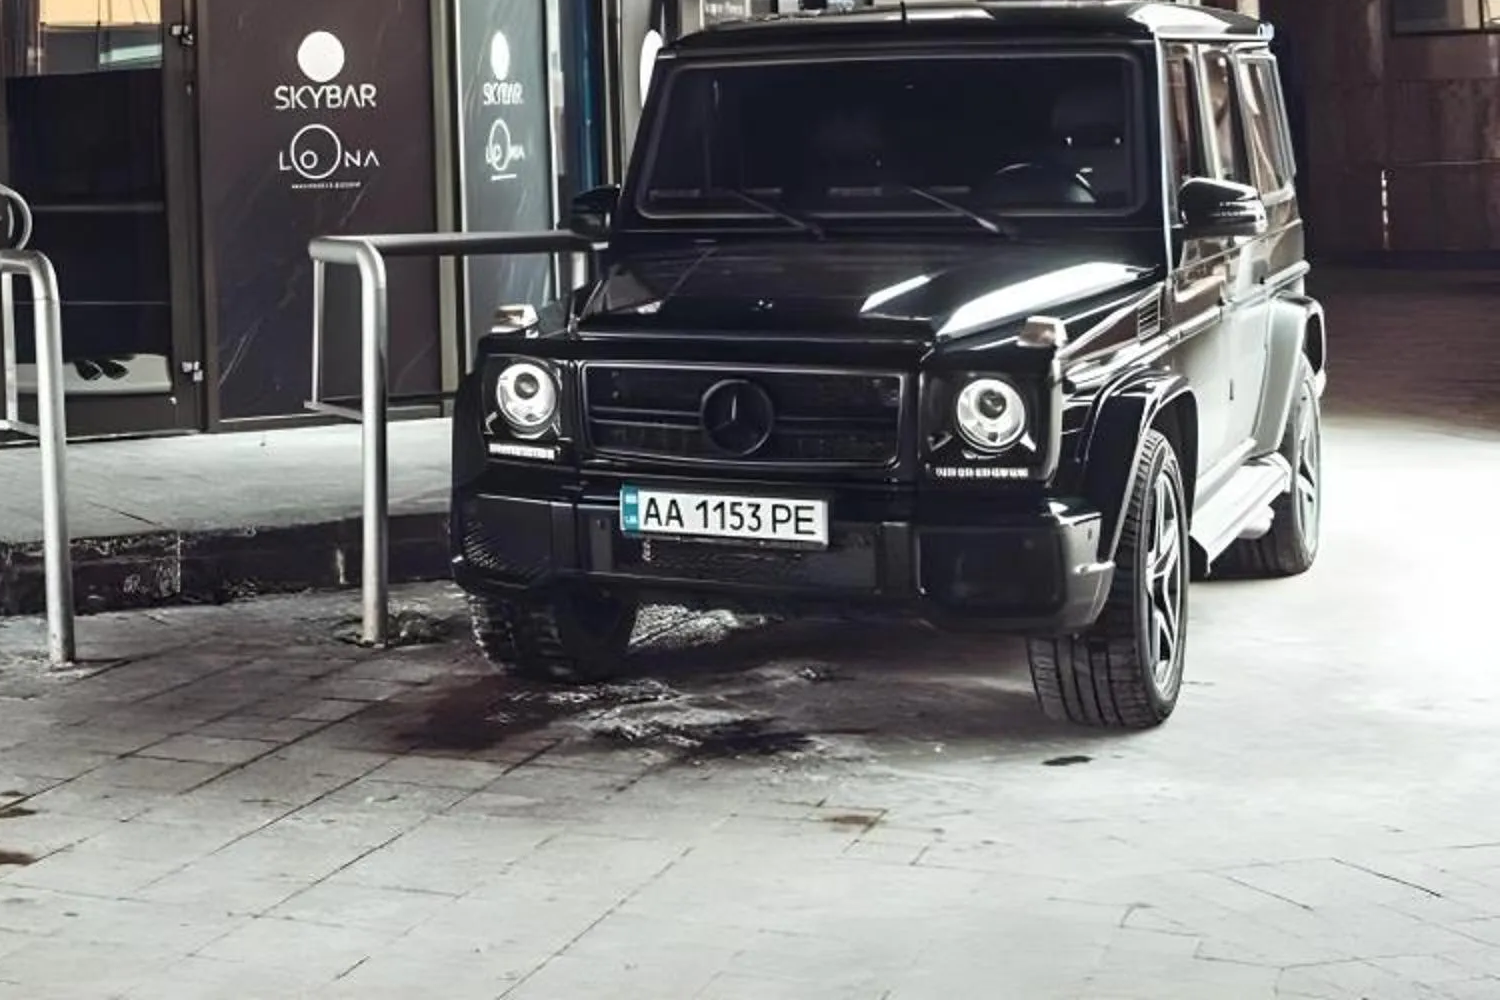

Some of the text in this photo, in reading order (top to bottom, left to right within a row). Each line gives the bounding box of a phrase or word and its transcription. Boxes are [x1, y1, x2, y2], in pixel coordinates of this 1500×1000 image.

[274, 83, 377, 110] SKYBAR
[644, 497, 816, 535] AA 1153 PE
